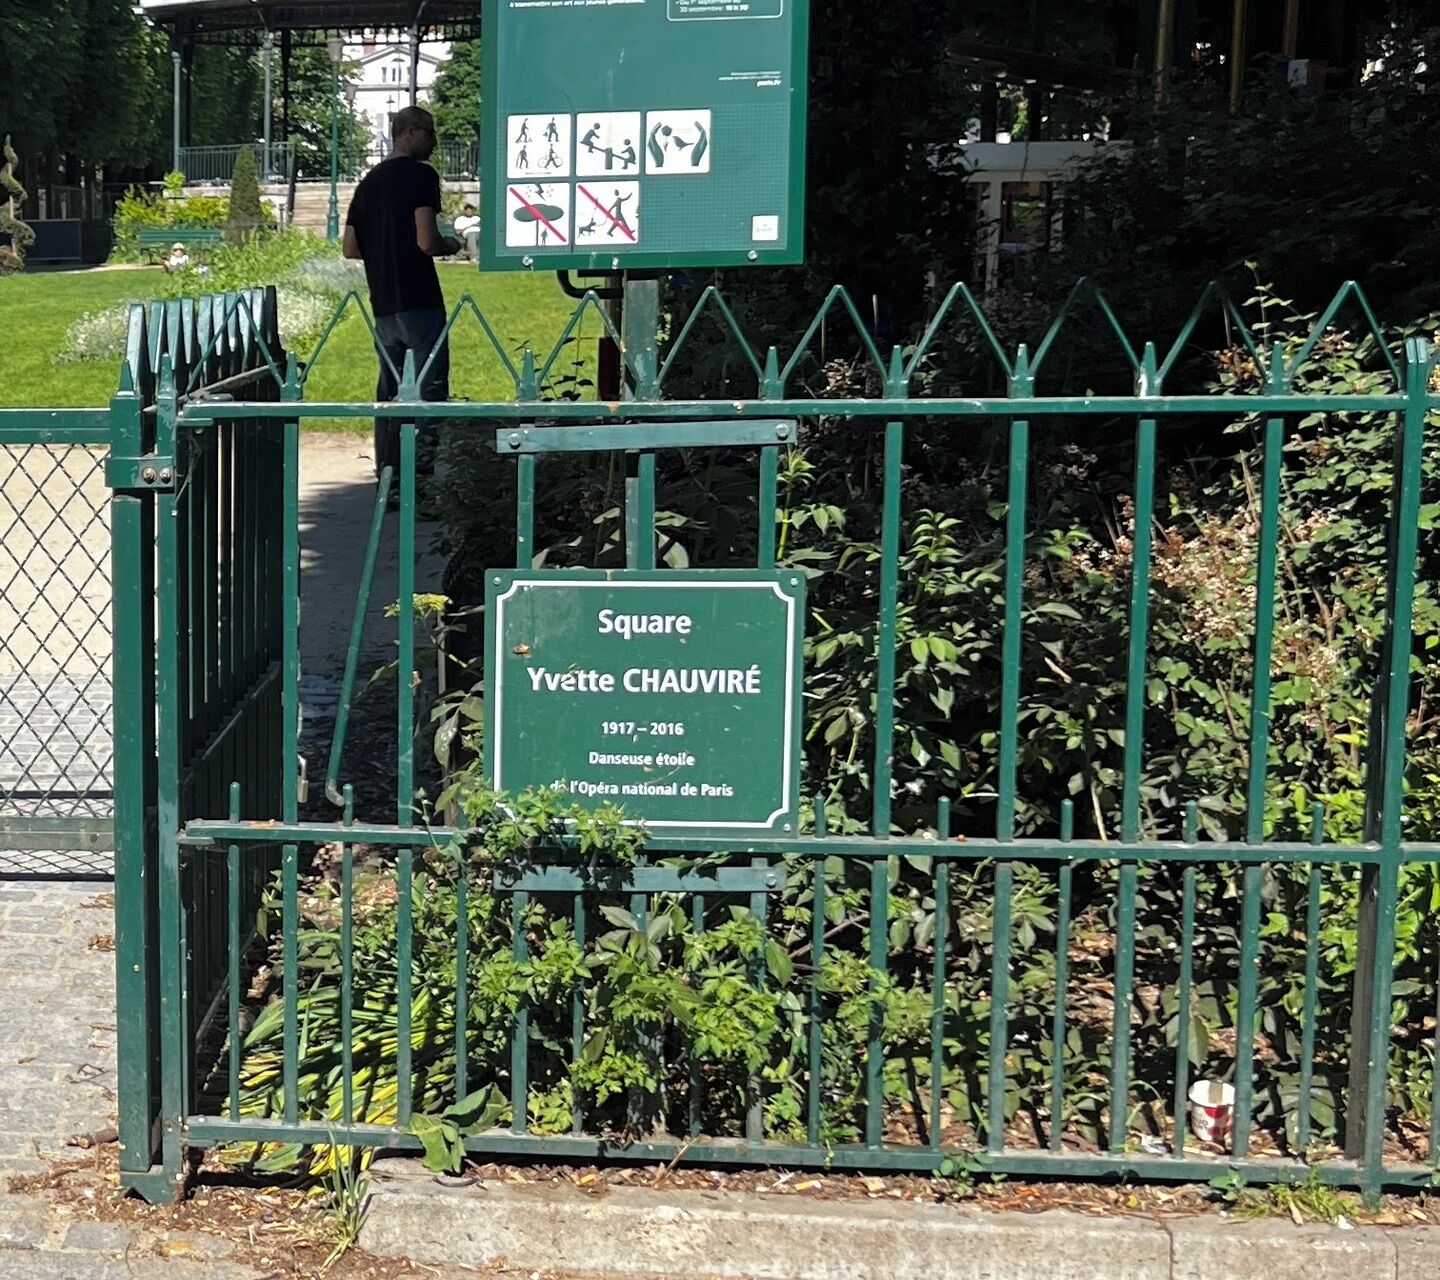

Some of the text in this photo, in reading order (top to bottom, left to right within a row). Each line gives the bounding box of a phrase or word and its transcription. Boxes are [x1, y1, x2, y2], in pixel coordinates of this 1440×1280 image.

[598, 608, 691, 640] Square
[527, 663, 761, 694] Yvette CHAUVIRÉ
[601, 721, 634, 736] 1917
[649, 721, 684, 736] 2016
[588, 749, 695, 766] Danseuse étoile
[570, 780, 619, 797] l'Opéra
[622, 781, 678, 796] national
[681, 781, 698, 796] de
[701, 782, 733, 797] Paris
